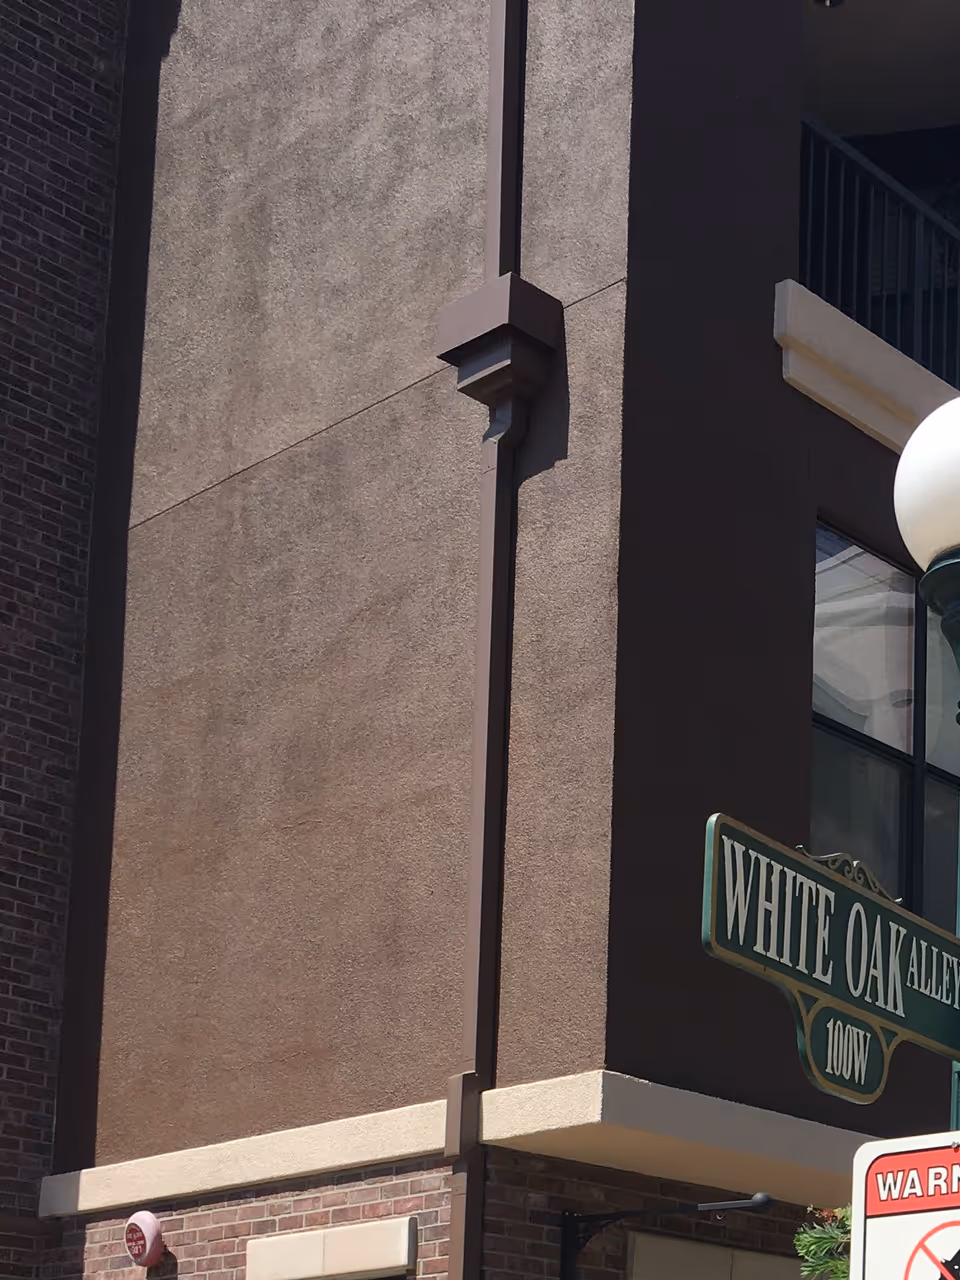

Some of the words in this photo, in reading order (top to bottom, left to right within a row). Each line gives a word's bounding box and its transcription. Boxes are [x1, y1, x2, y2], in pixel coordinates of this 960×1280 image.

[722, 835, 835, 986] WHITE
[845, 902, 907, 1019] OAK
[824, 1016, 871, 1087] 100W
